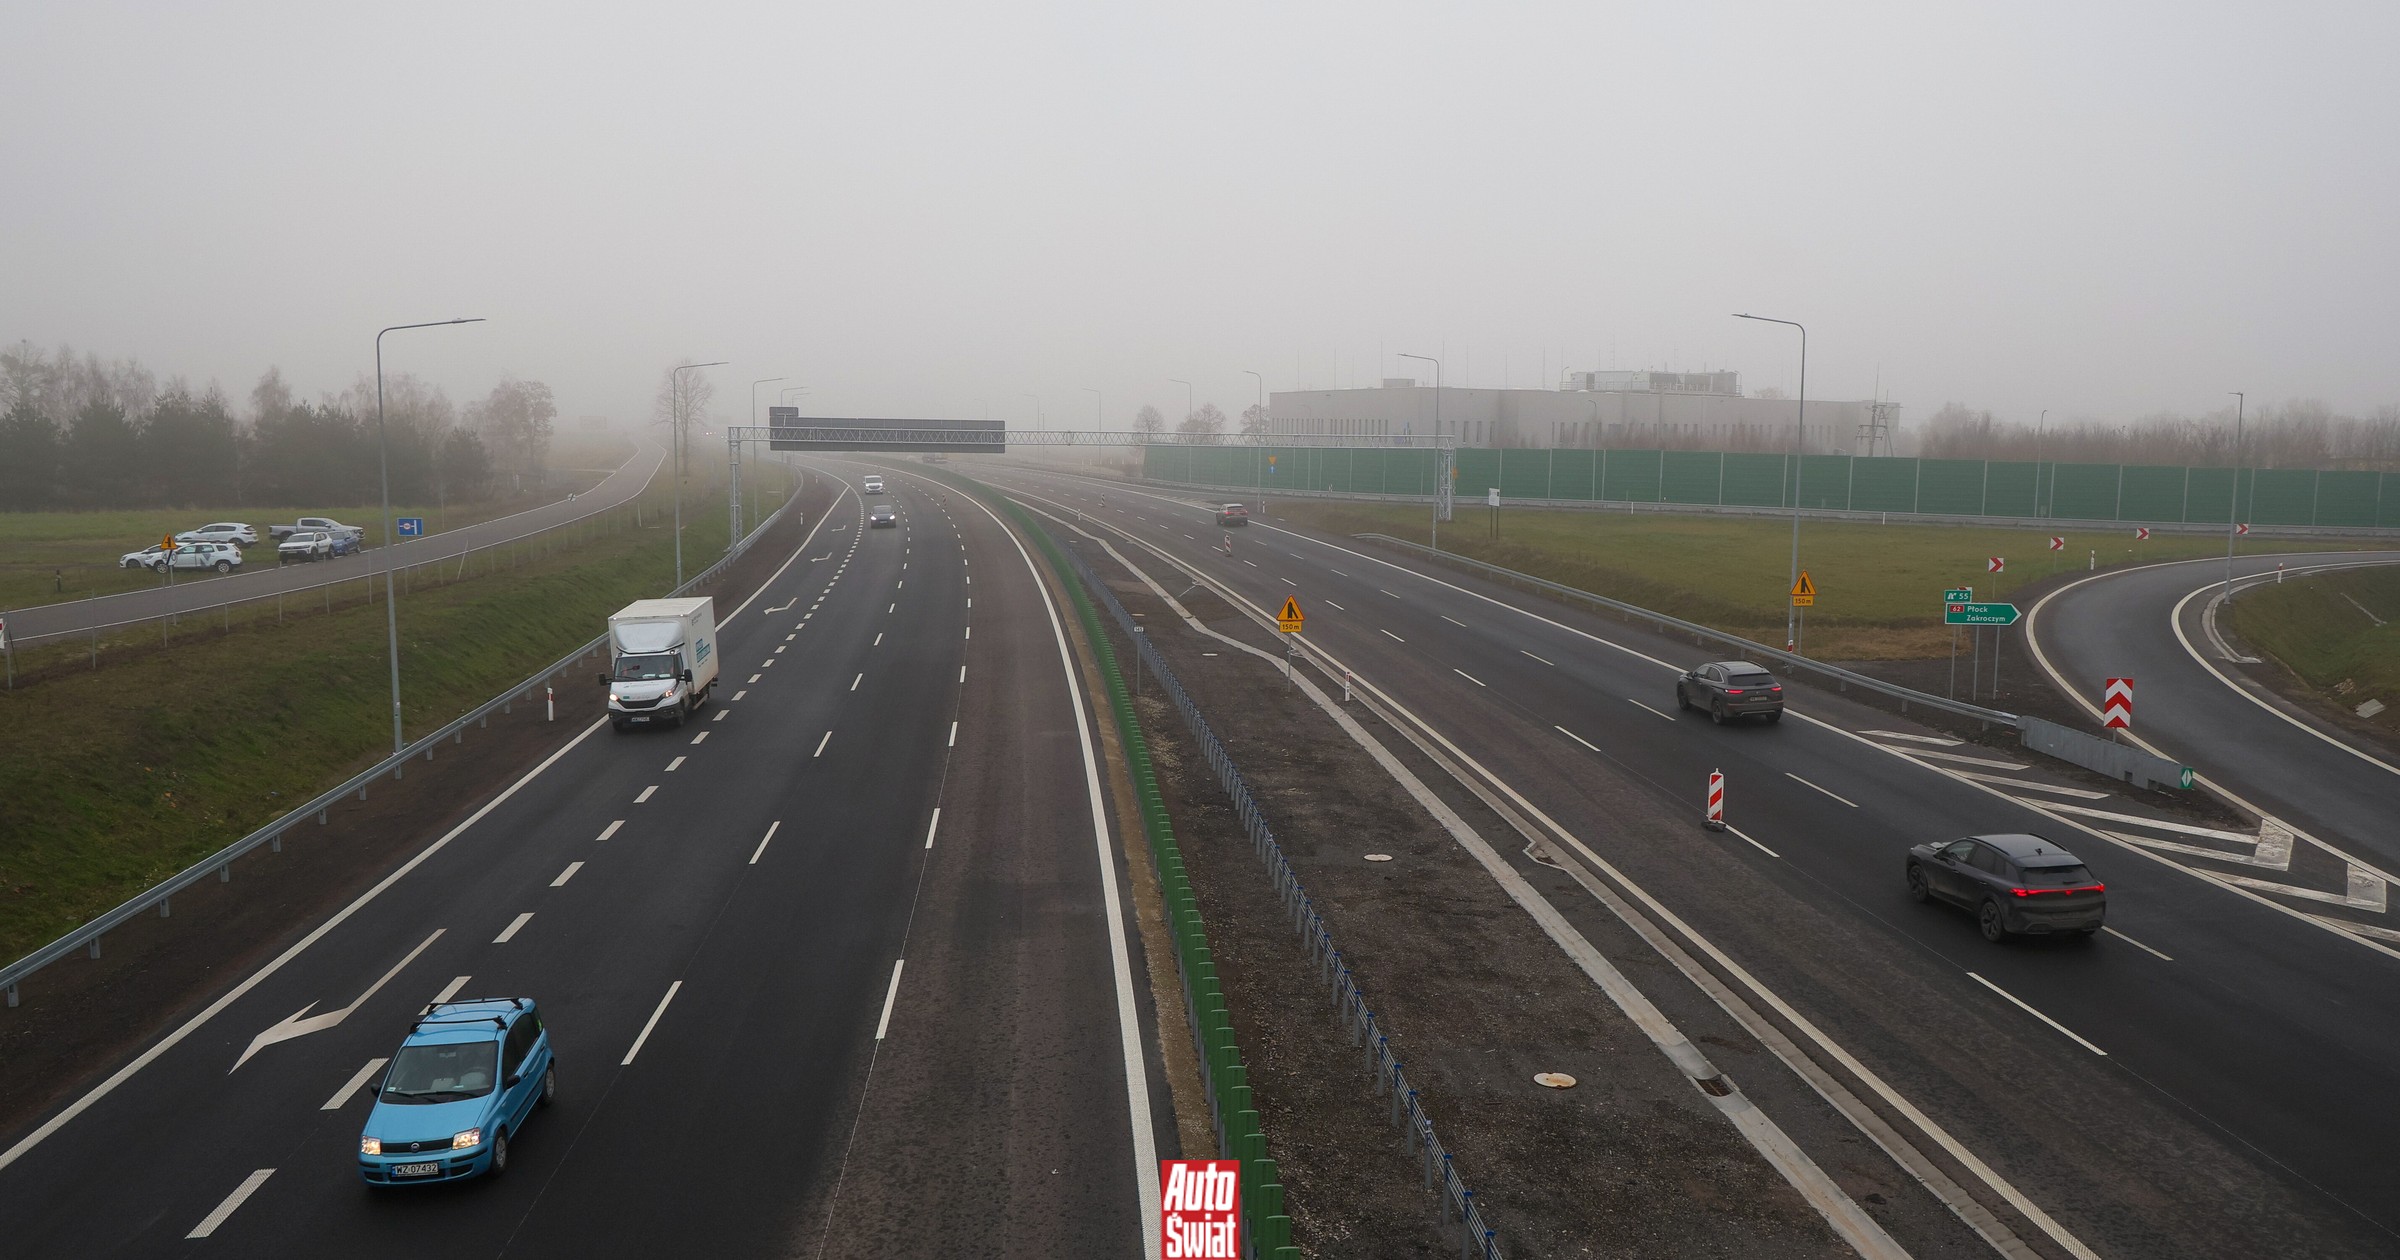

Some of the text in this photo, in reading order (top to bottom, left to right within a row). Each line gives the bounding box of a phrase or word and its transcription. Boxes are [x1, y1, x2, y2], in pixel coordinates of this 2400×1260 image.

[1967, 605, 1988, 613] Płock
[1966, 615, 2006, 623] Zakroczym
[396, 1164, 436, 1173] WZ 07432
